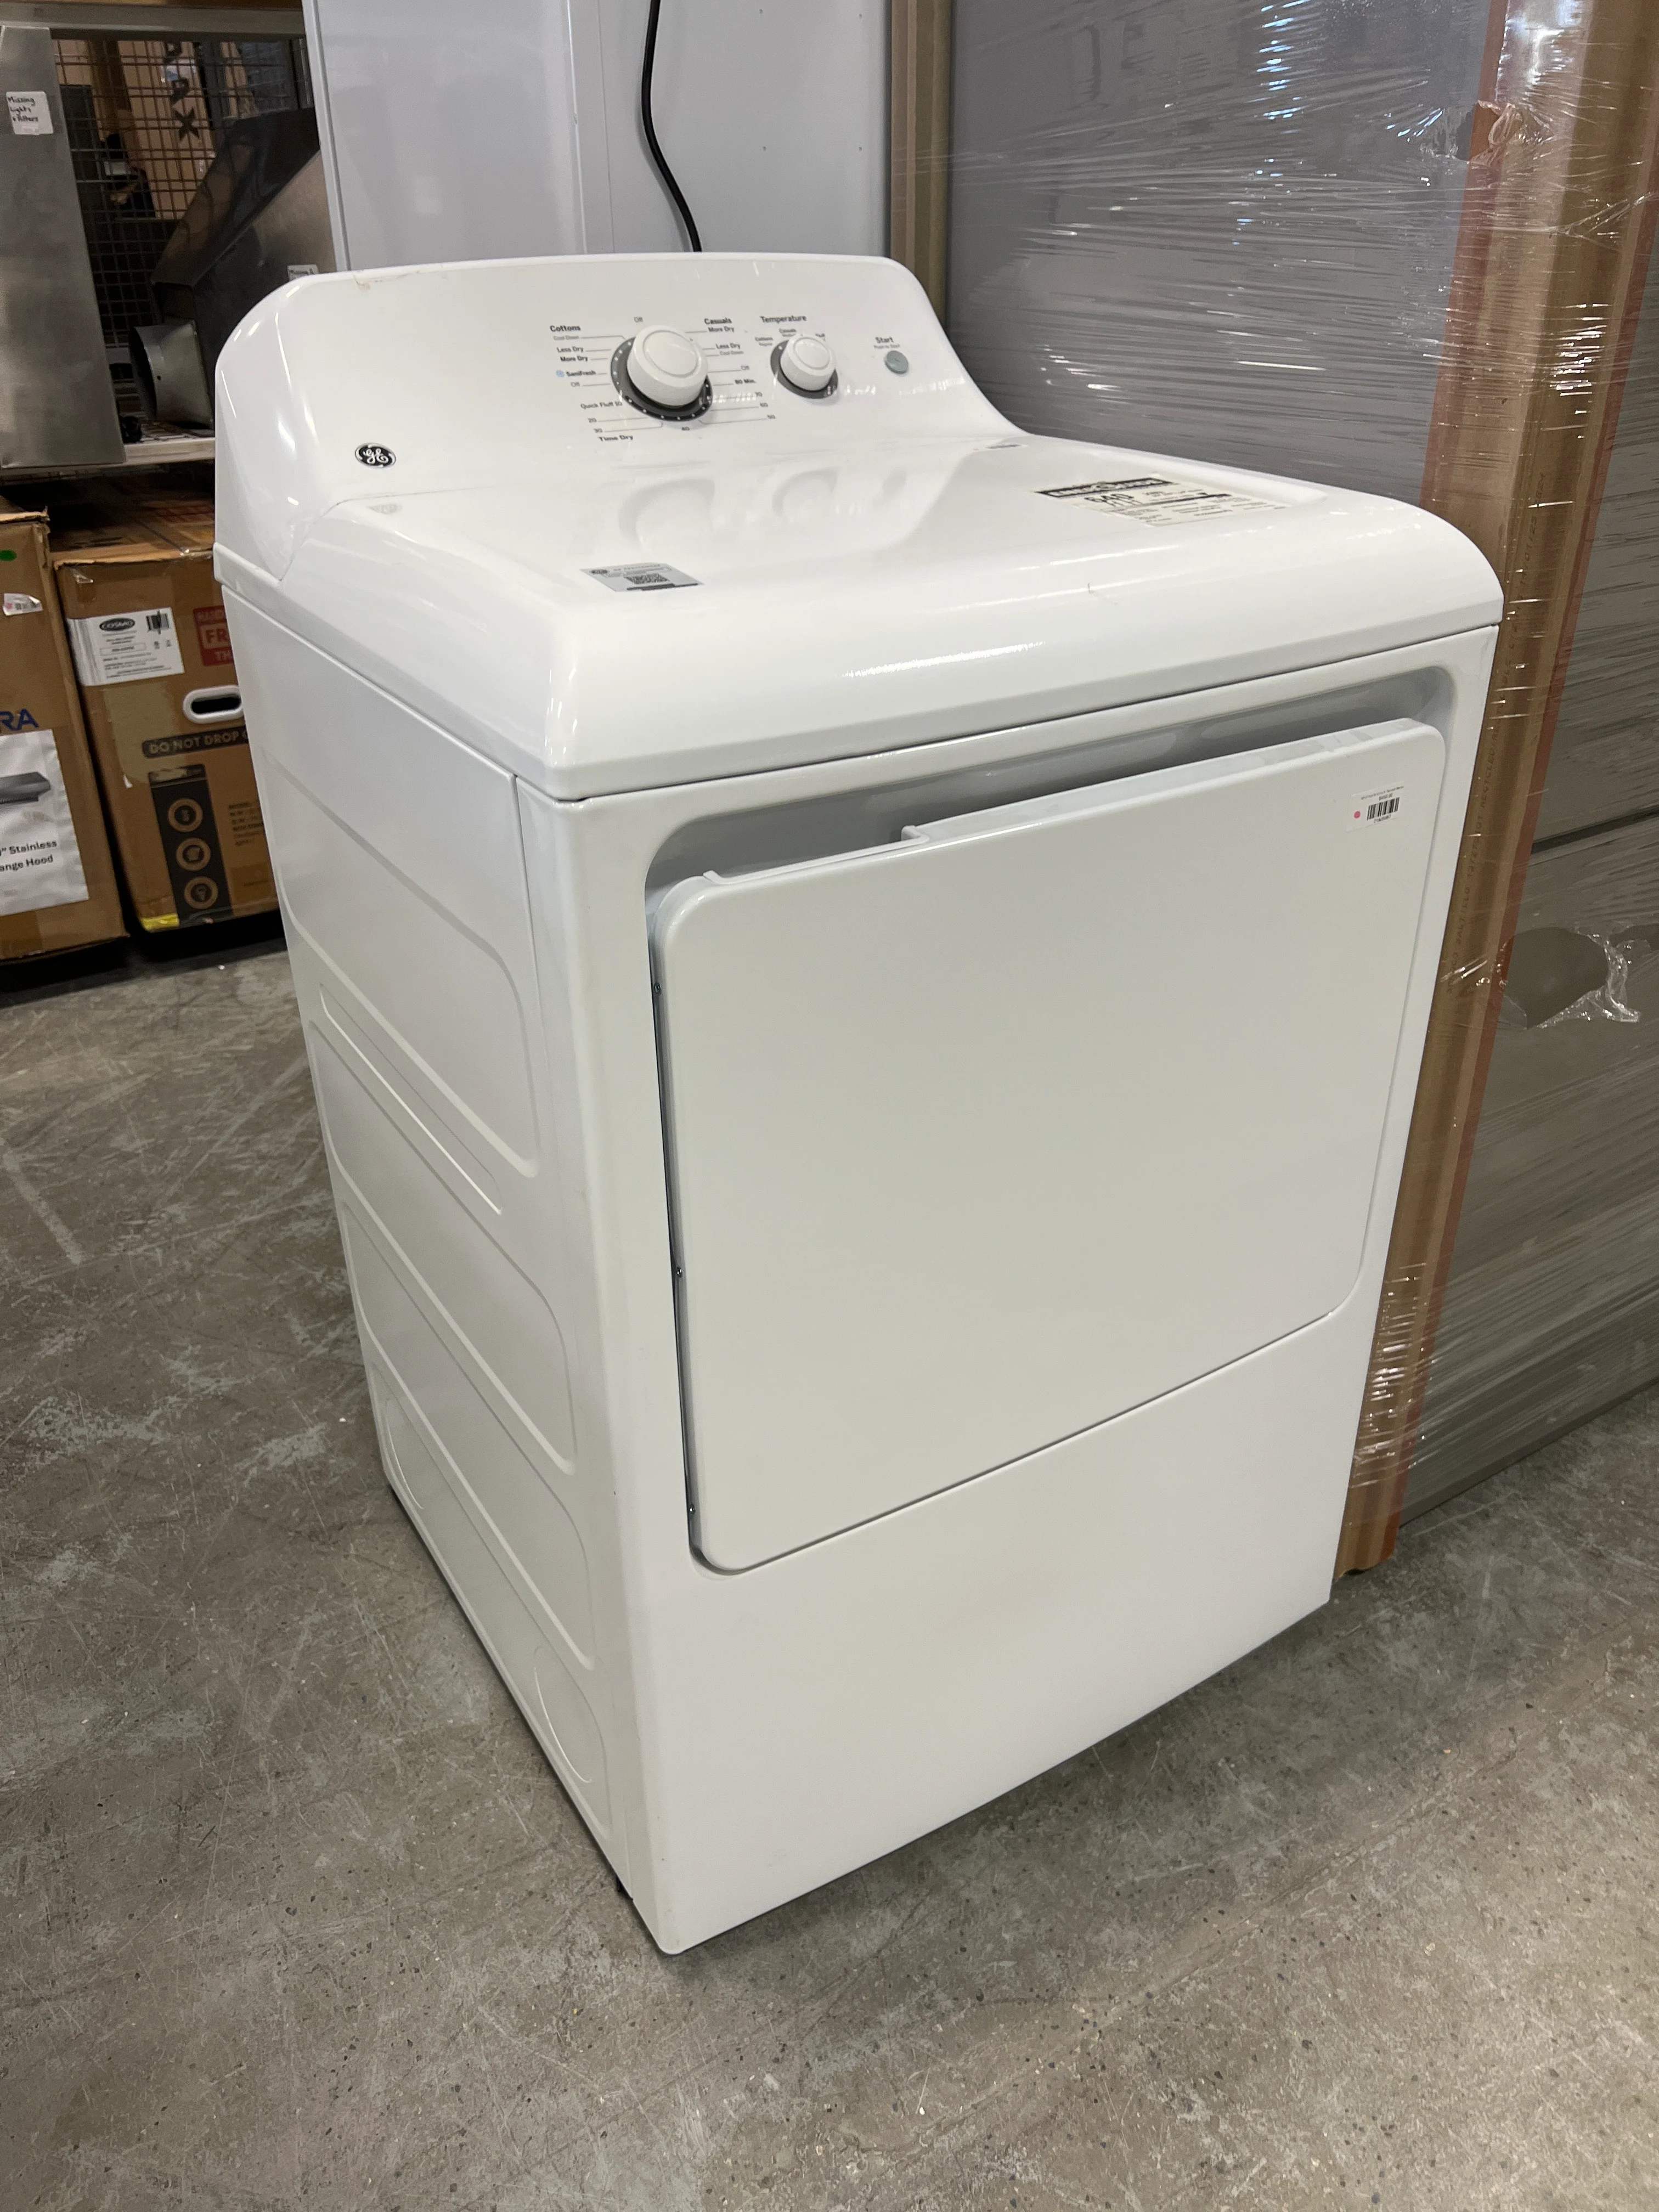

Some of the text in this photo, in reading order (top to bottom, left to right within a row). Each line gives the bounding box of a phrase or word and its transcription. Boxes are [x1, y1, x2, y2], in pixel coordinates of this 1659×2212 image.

[760, 315, 806, 324] Temperature
[149, 741, 171, 754] DO
[173, 737, 200, 751] NOT
[204, 731, 239, 745] DROP
[9, 840, 57, 854] Stainless
[25, 854, 53, 867] Hood
